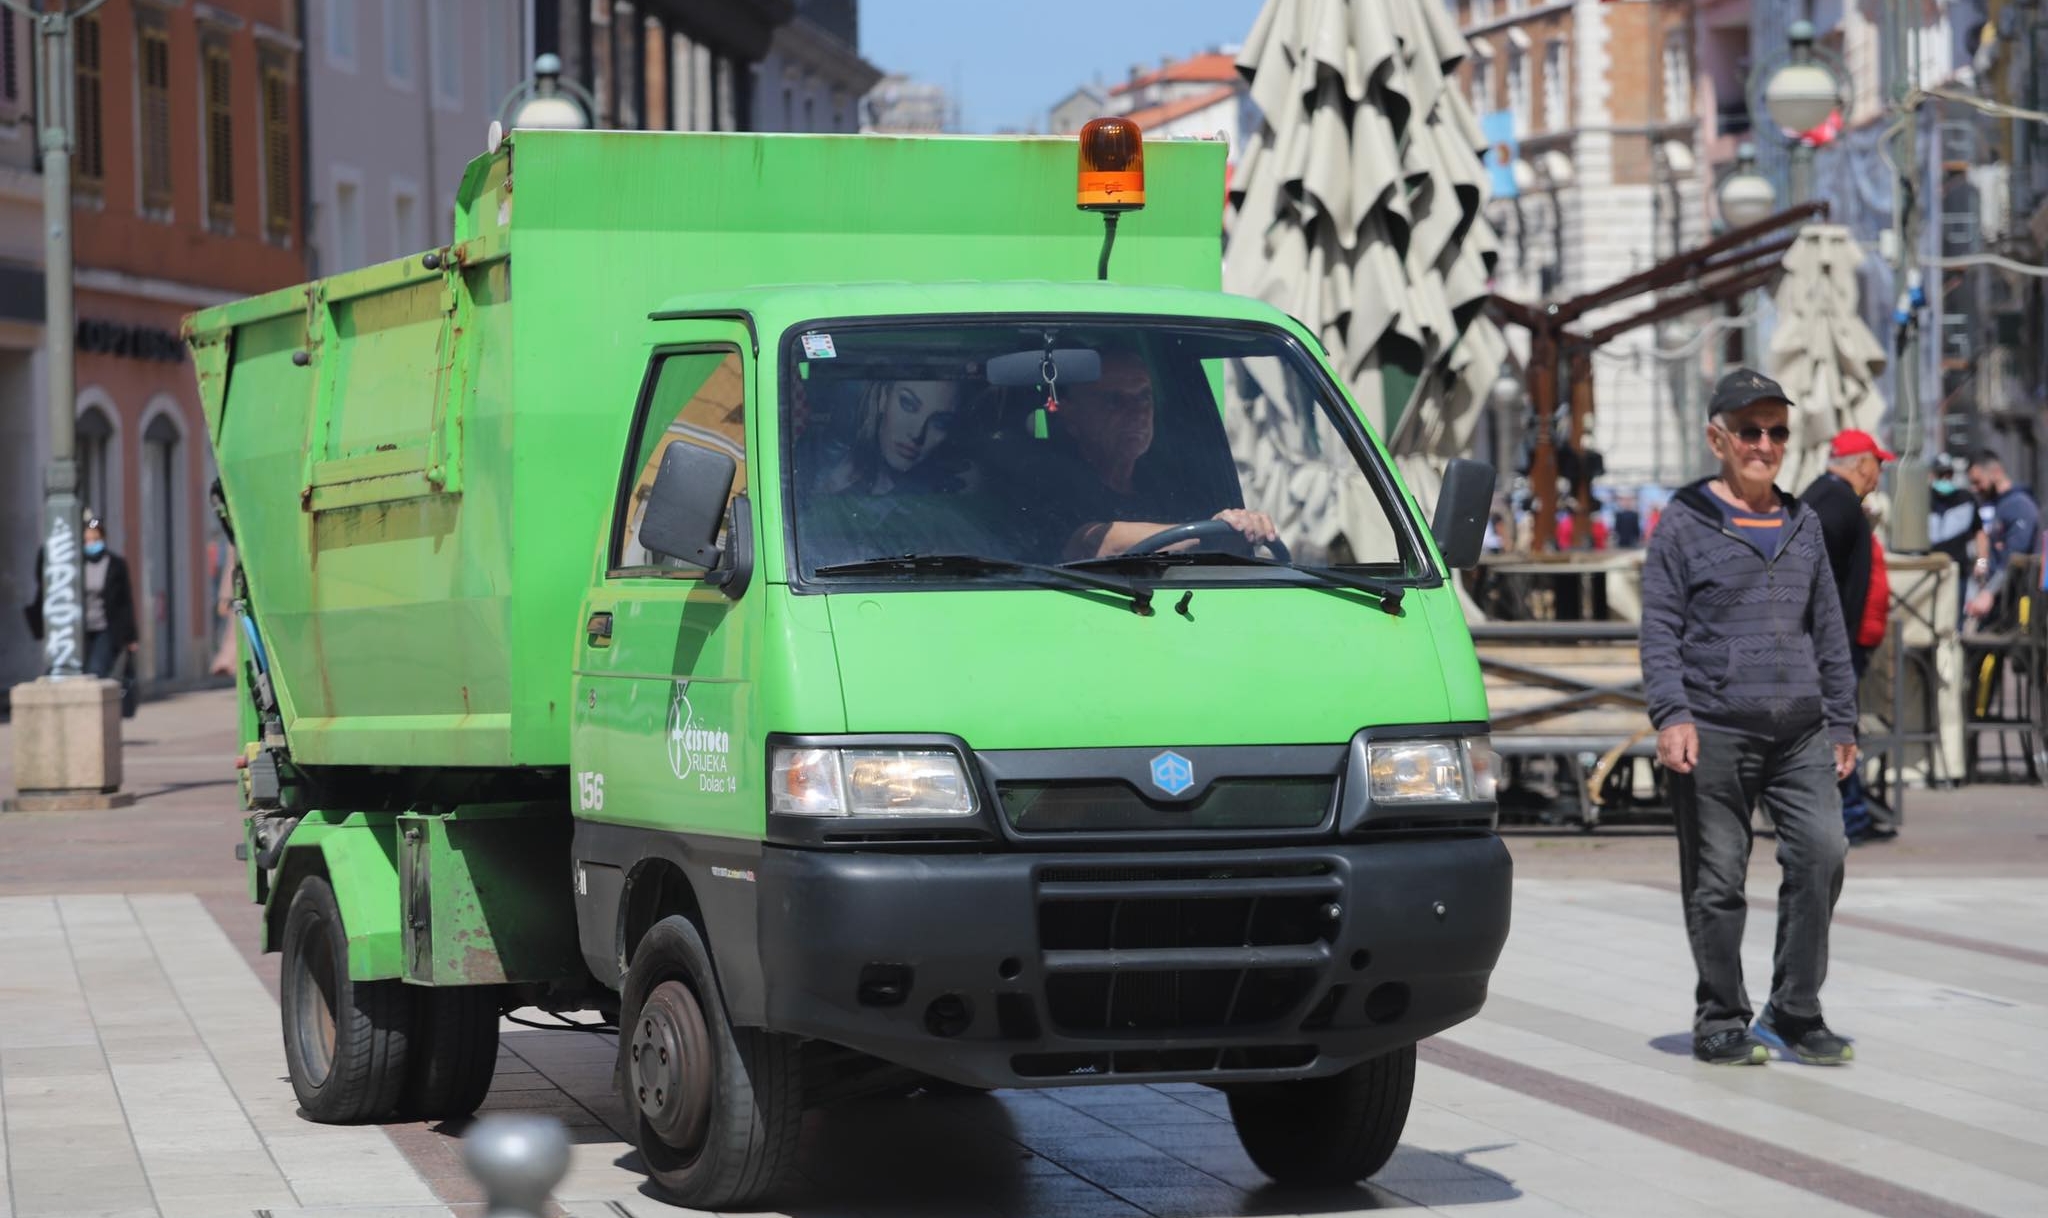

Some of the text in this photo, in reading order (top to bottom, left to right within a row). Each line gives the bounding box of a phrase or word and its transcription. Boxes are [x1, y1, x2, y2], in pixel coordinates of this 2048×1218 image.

[692, 753, 727, 772] RIJEKA
[578, 771, 604, 811] 156
[699, 773, 736, 793] Dolac 14
